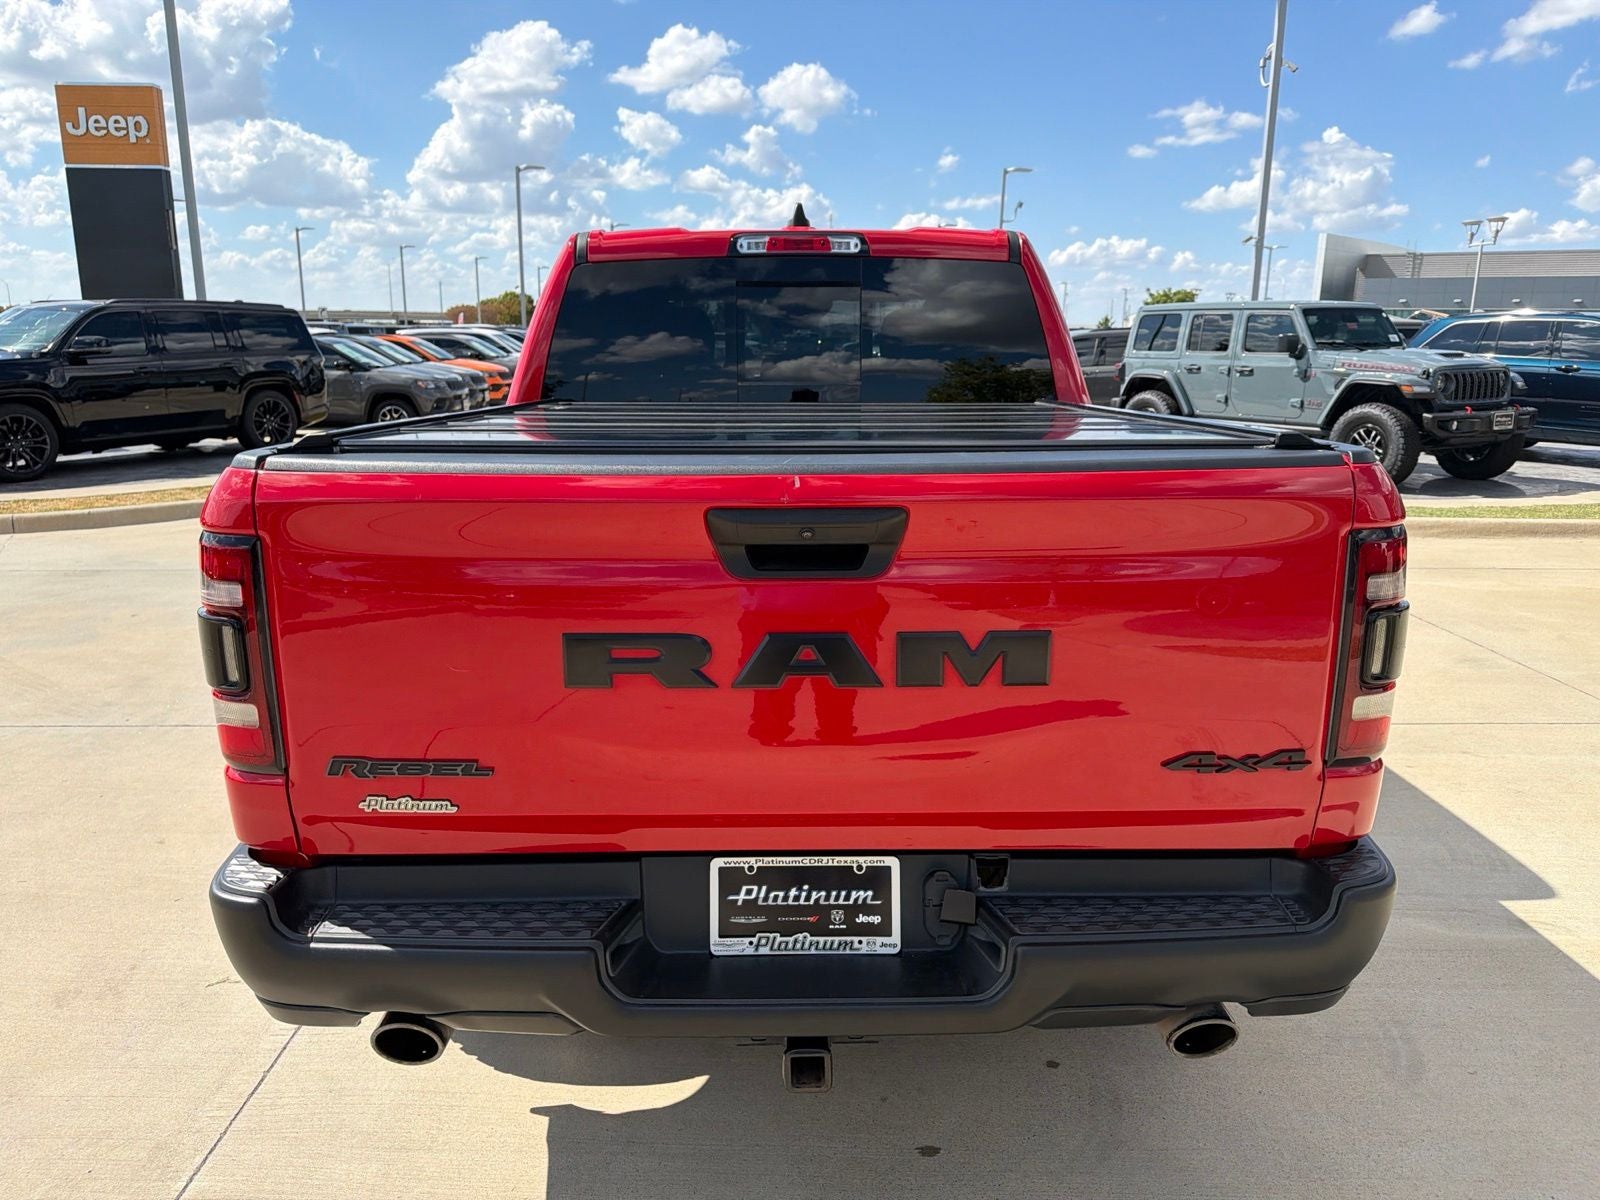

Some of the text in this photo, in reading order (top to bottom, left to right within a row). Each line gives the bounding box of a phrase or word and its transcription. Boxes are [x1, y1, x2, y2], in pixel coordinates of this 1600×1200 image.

[65, 106, 149, 143] Jeep
[562, 630, 1052, 689] RAM
[327, 757, 494, 779] REBEL
[358, 796, 458, 813] Platinum
[723, 858, 886, 866] www.PlatinumCDRJTexas.com
[726, 885, 883, 906] Platinum
[855, 913, 882, 925] Jeep
[754, 934, 861, 953] Platinum
[879, 941, 898, 949] Jeep
